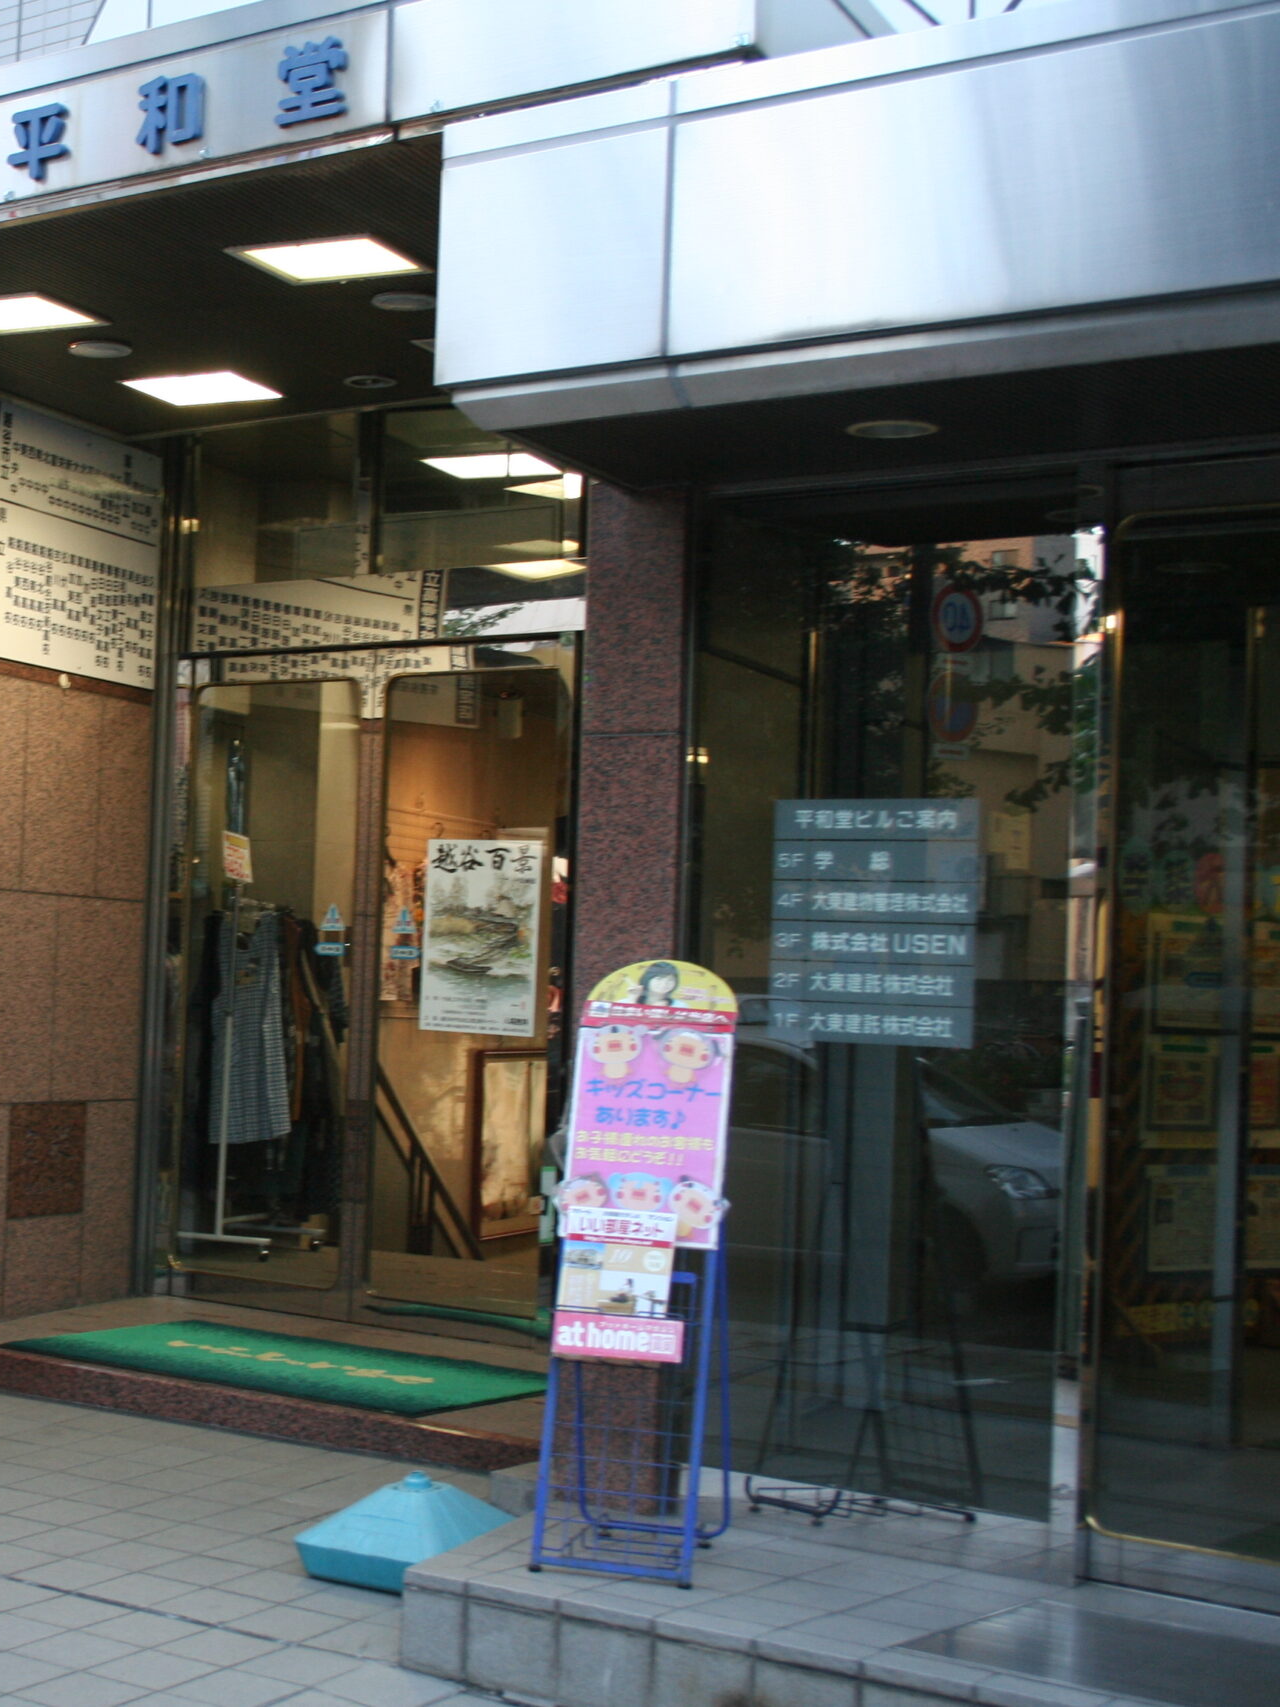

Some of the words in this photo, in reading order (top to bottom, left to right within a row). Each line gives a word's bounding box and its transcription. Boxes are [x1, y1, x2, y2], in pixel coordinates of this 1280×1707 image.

[7, 36, 349, 181] 平和堂
[795, 810, 958, 829] 平和堂ビルご案内
[432, 844, 537, 873] 越谷百景
[777, 853, 805, 868] 5F
[777, 893, 805, 908] 4F
[775, 933, 802, 948] 3F
[812, 932, 888, 952] 株式会社
[893, 934, 967, 955] USEN
[773, 973, 801, 988] 2F
[809, 973, 954, 997] 大東建託株式会社
[774, 1013, 800, 1028] 1F
[808, 1012, 953, 1038] 大東建託株式会社
[586, 1079, 722, 1102] キッズコーナー
[557, 1321, 585, 1347] at
[587, 1321, 649, 1353] home
